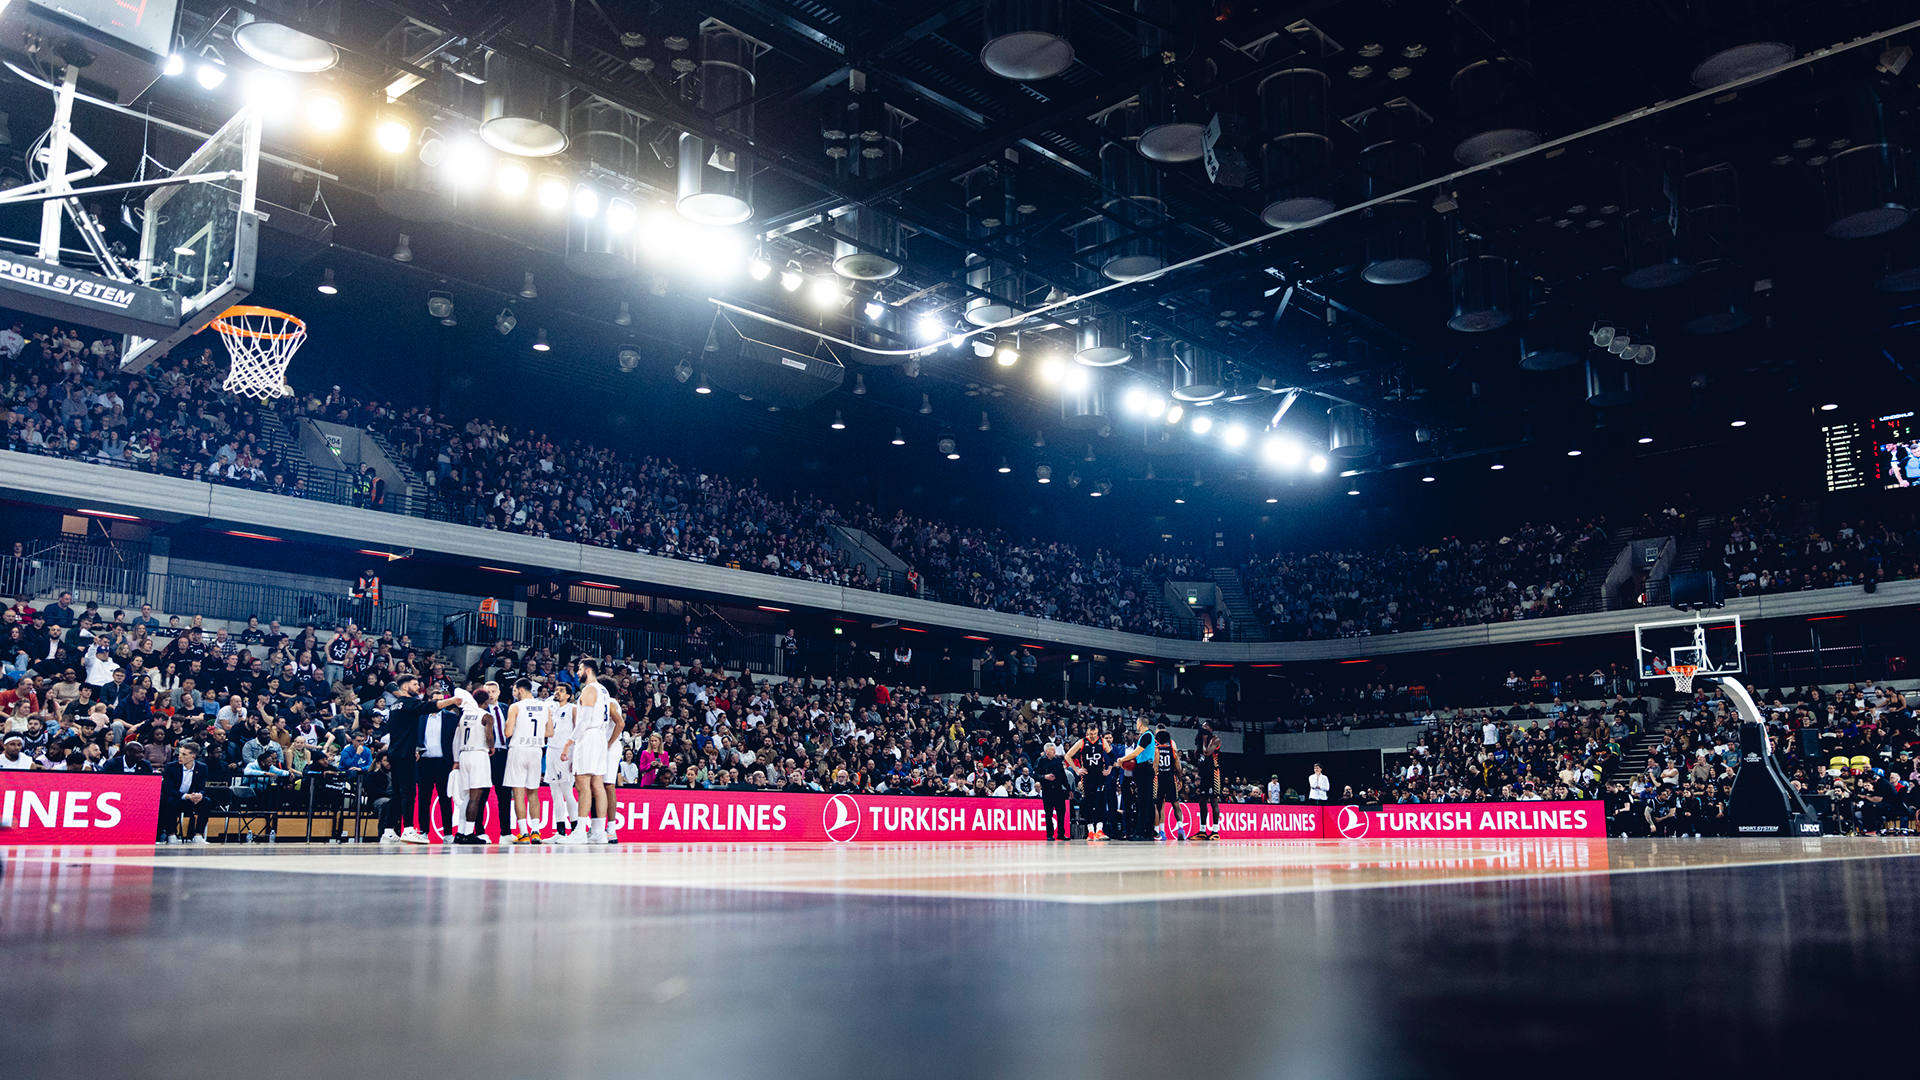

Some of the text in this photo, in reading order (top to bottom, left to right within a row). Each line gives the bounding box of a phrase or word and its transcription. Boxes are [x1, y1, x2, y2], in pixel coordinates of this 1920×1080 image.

[53, 274, 136, 304] SYSTEM
[659, 802, 787, 831] AIRLINES
[869, 806, 965, 831] TURKISH
[1260, 813, 1316, 832] AIRLINES
[1376, 809, 1588, 831] TURKISH AIRLINES
